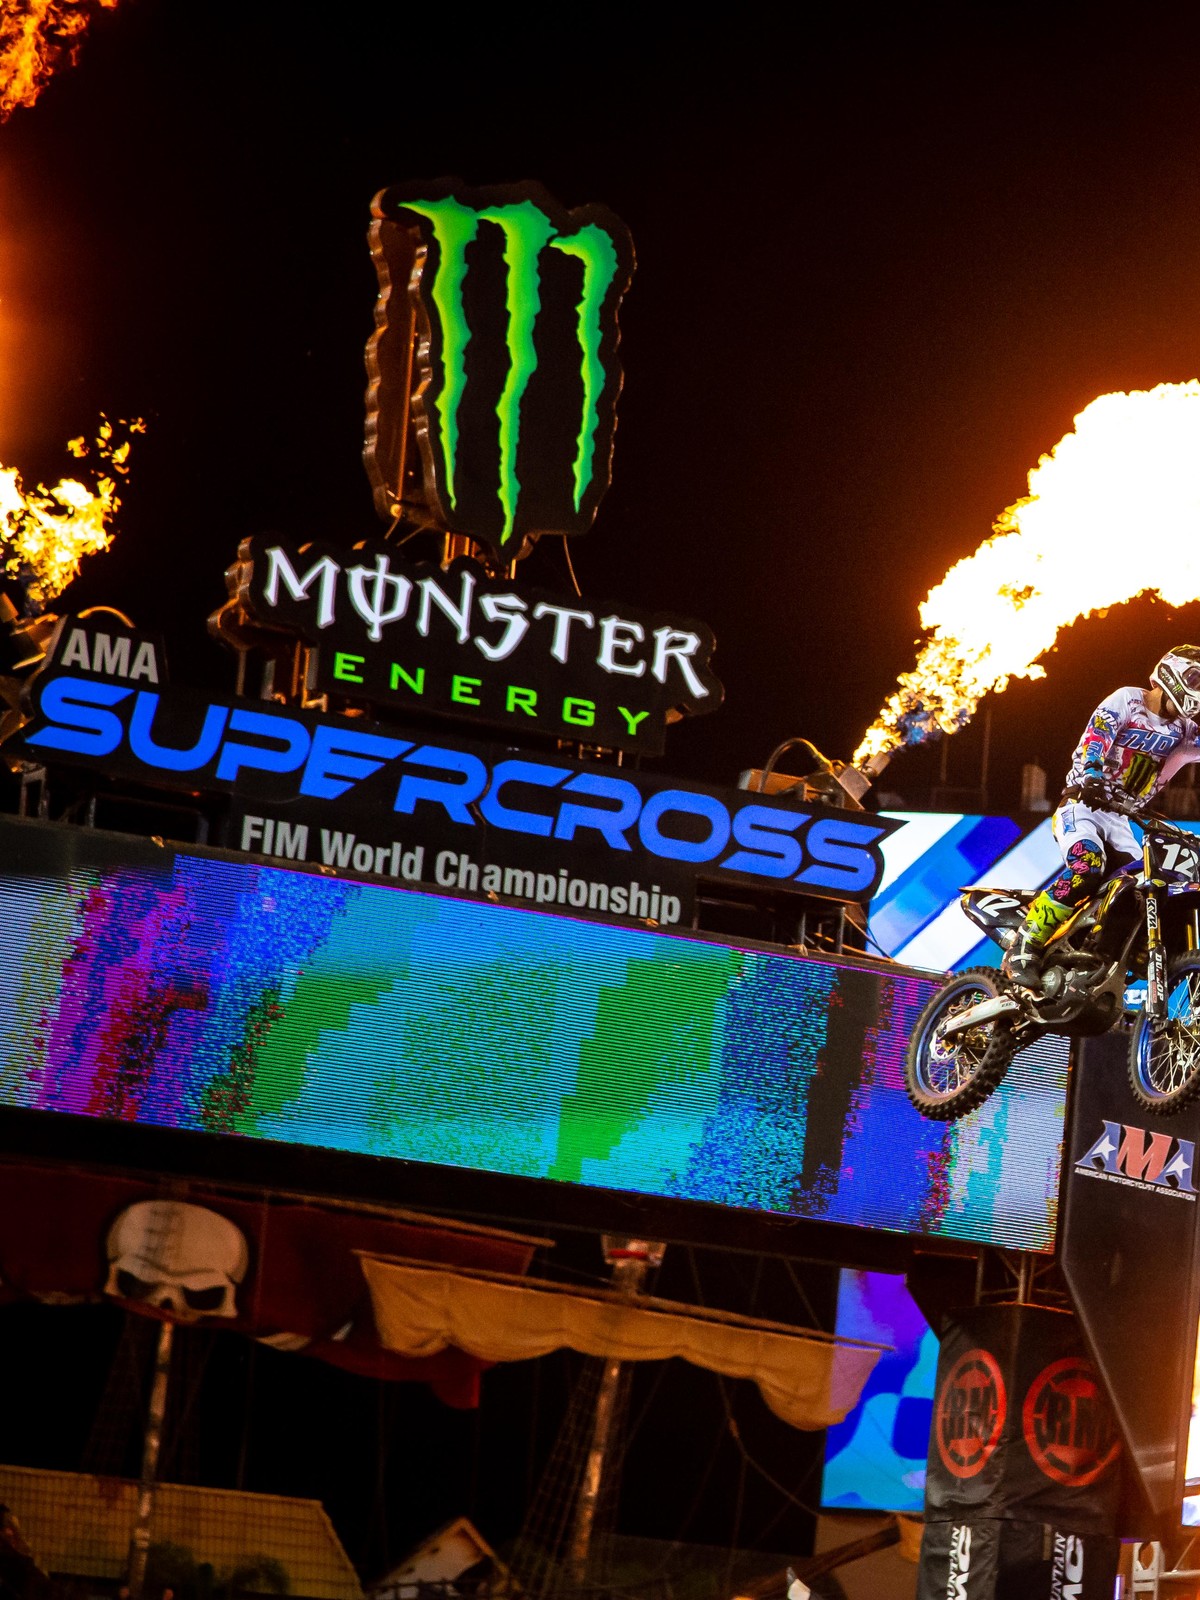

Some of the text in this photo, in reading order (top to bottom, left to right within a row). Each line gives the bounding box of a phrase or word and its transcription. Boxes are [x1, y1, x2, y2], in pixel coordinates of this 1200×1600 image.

[60, 628, 159, 684] AMA
[334, 651, 652, 736] ENERGY
[1116, 728, 1180, 758] THO
[25, 676, 886, 892] SUPERCROSS
[241, 815, 682, 925] FIM World Championship
[1161, 843, 1199, 879] 12
[1074, 1119, 1200, 1193] AMA
[1074, 1167, 1108, 1180] AMERICAN
